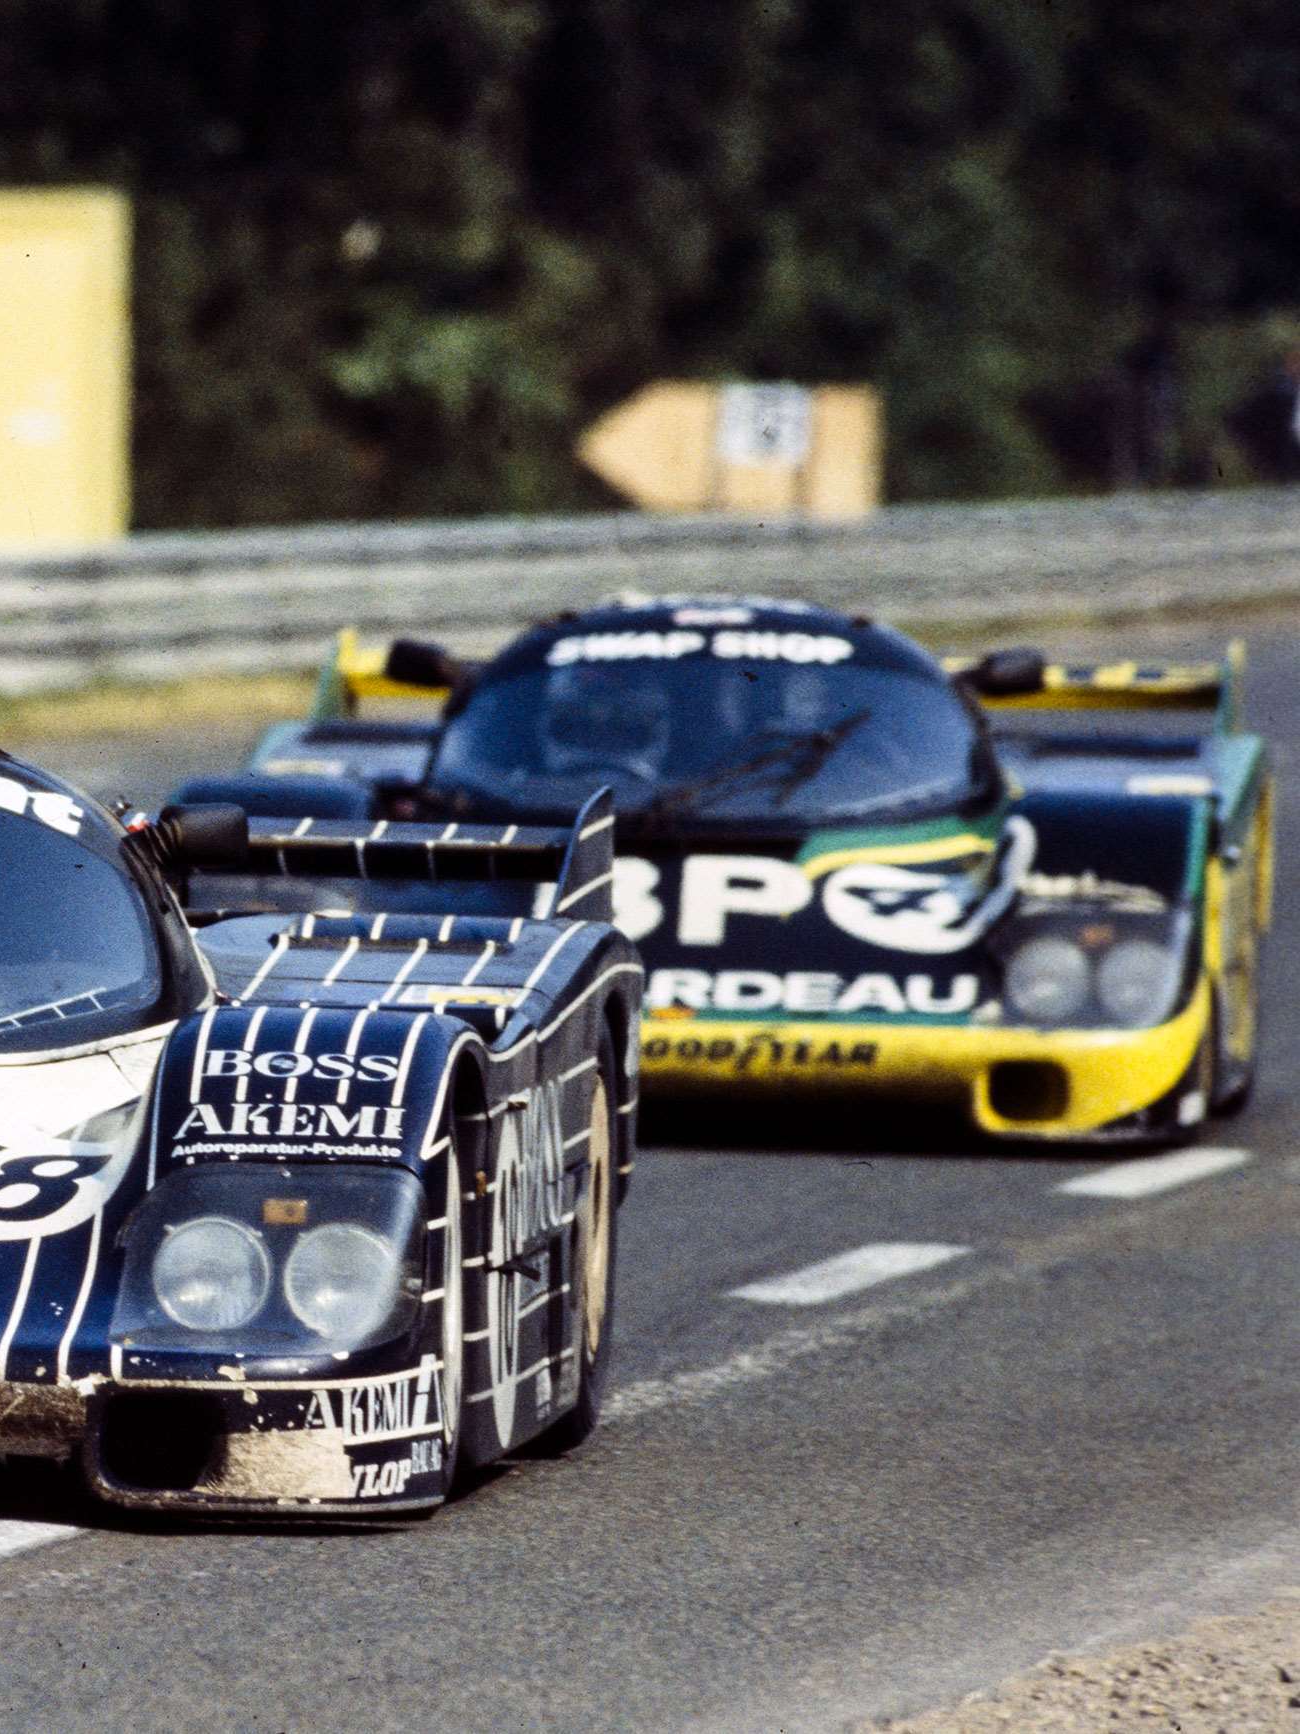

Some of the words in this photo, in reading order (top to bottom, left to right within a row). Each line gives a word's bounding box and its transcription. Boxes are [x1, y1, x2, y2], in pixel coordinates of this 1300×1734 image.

[711, 631, 854, 664] SHOP
[201, 1050, 399, 1082] BOSS
[172, 1103, 407, 1141] AKEMI
[171, 1142, 403, 1159] Autoreparatur-Produkte
